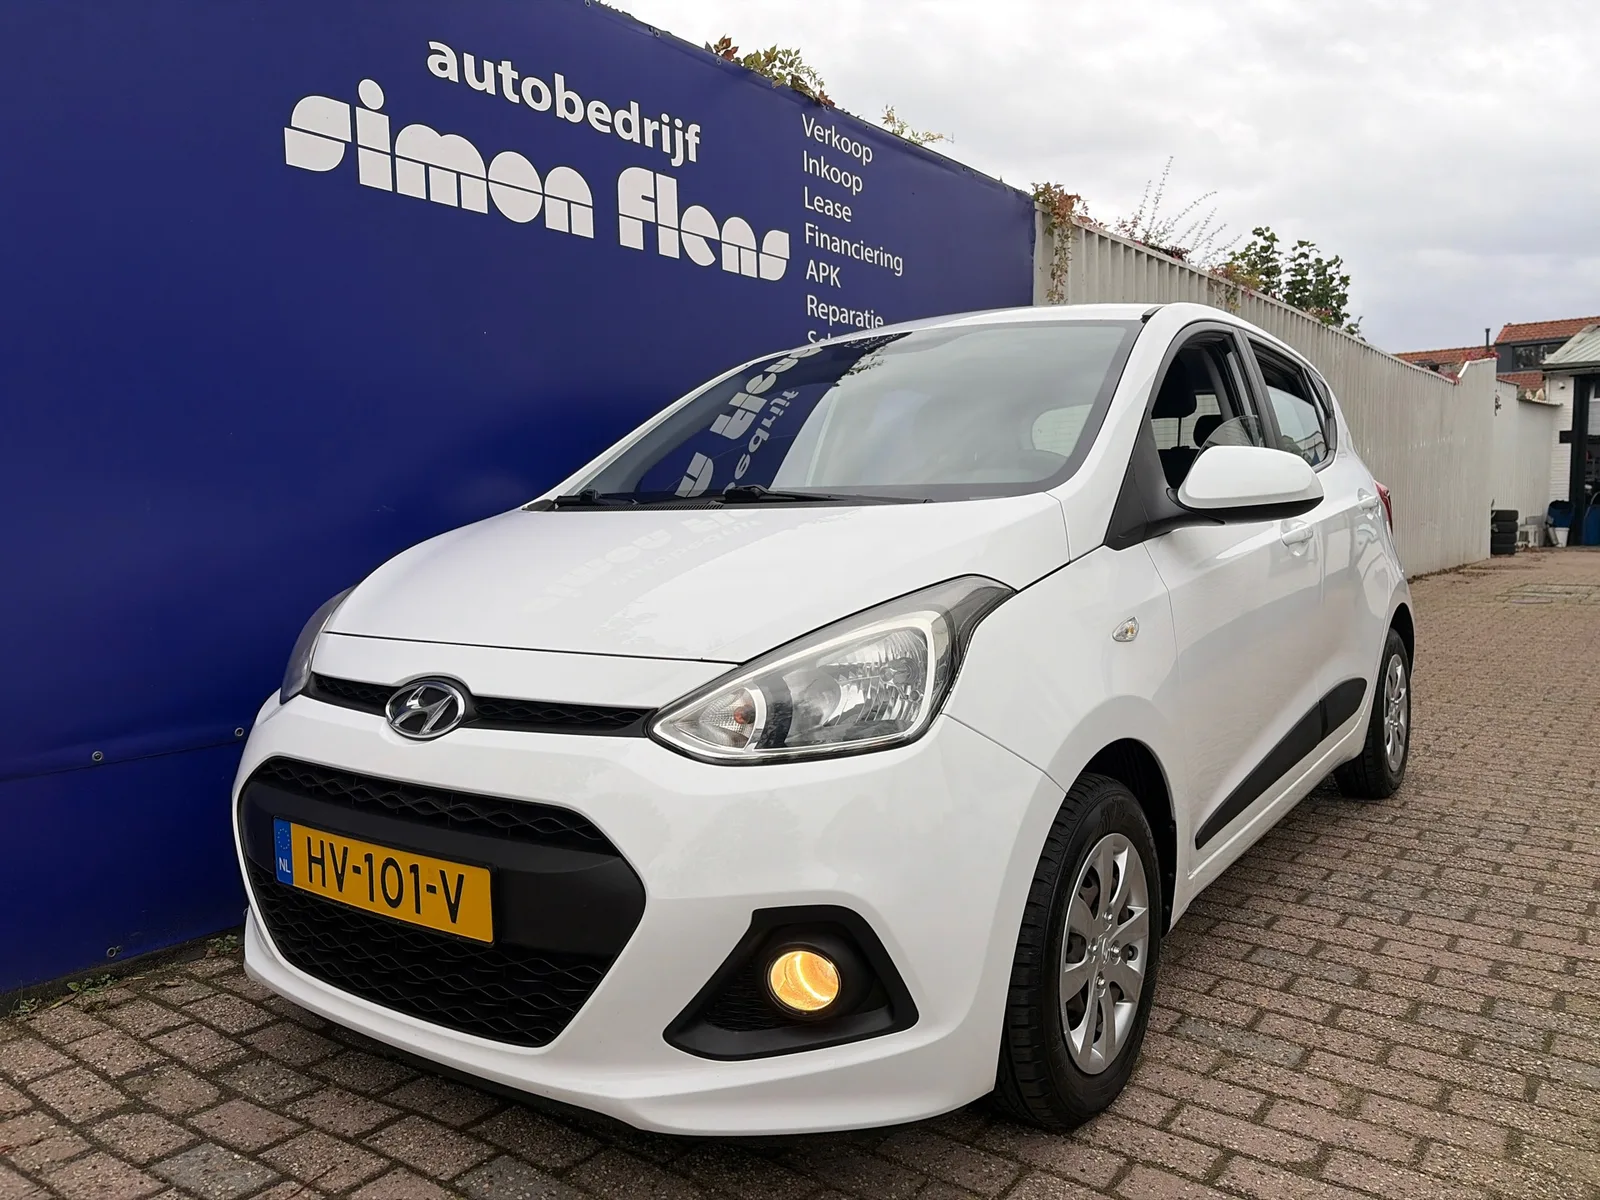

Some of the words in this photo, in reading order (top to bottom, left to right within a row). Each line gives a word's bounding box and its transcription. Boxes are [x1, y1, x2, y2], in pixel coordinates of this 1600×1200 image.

[427, 41, 701, 167] autobedrijf
[284, 79, 594, 239] simon
[802, 113, 873, 166] Verkoop
[803, 150, 863, 195] Inkoop
[804, 186, 852, 222] Lease
[805, 222, 903, 277] Financiering
[806, 259, 842, 288] APK
[807, 294, 884, 328] Reparatie
[278, 856, 292, 874] NL
[306, 836, 465, 924] HV-101-V
